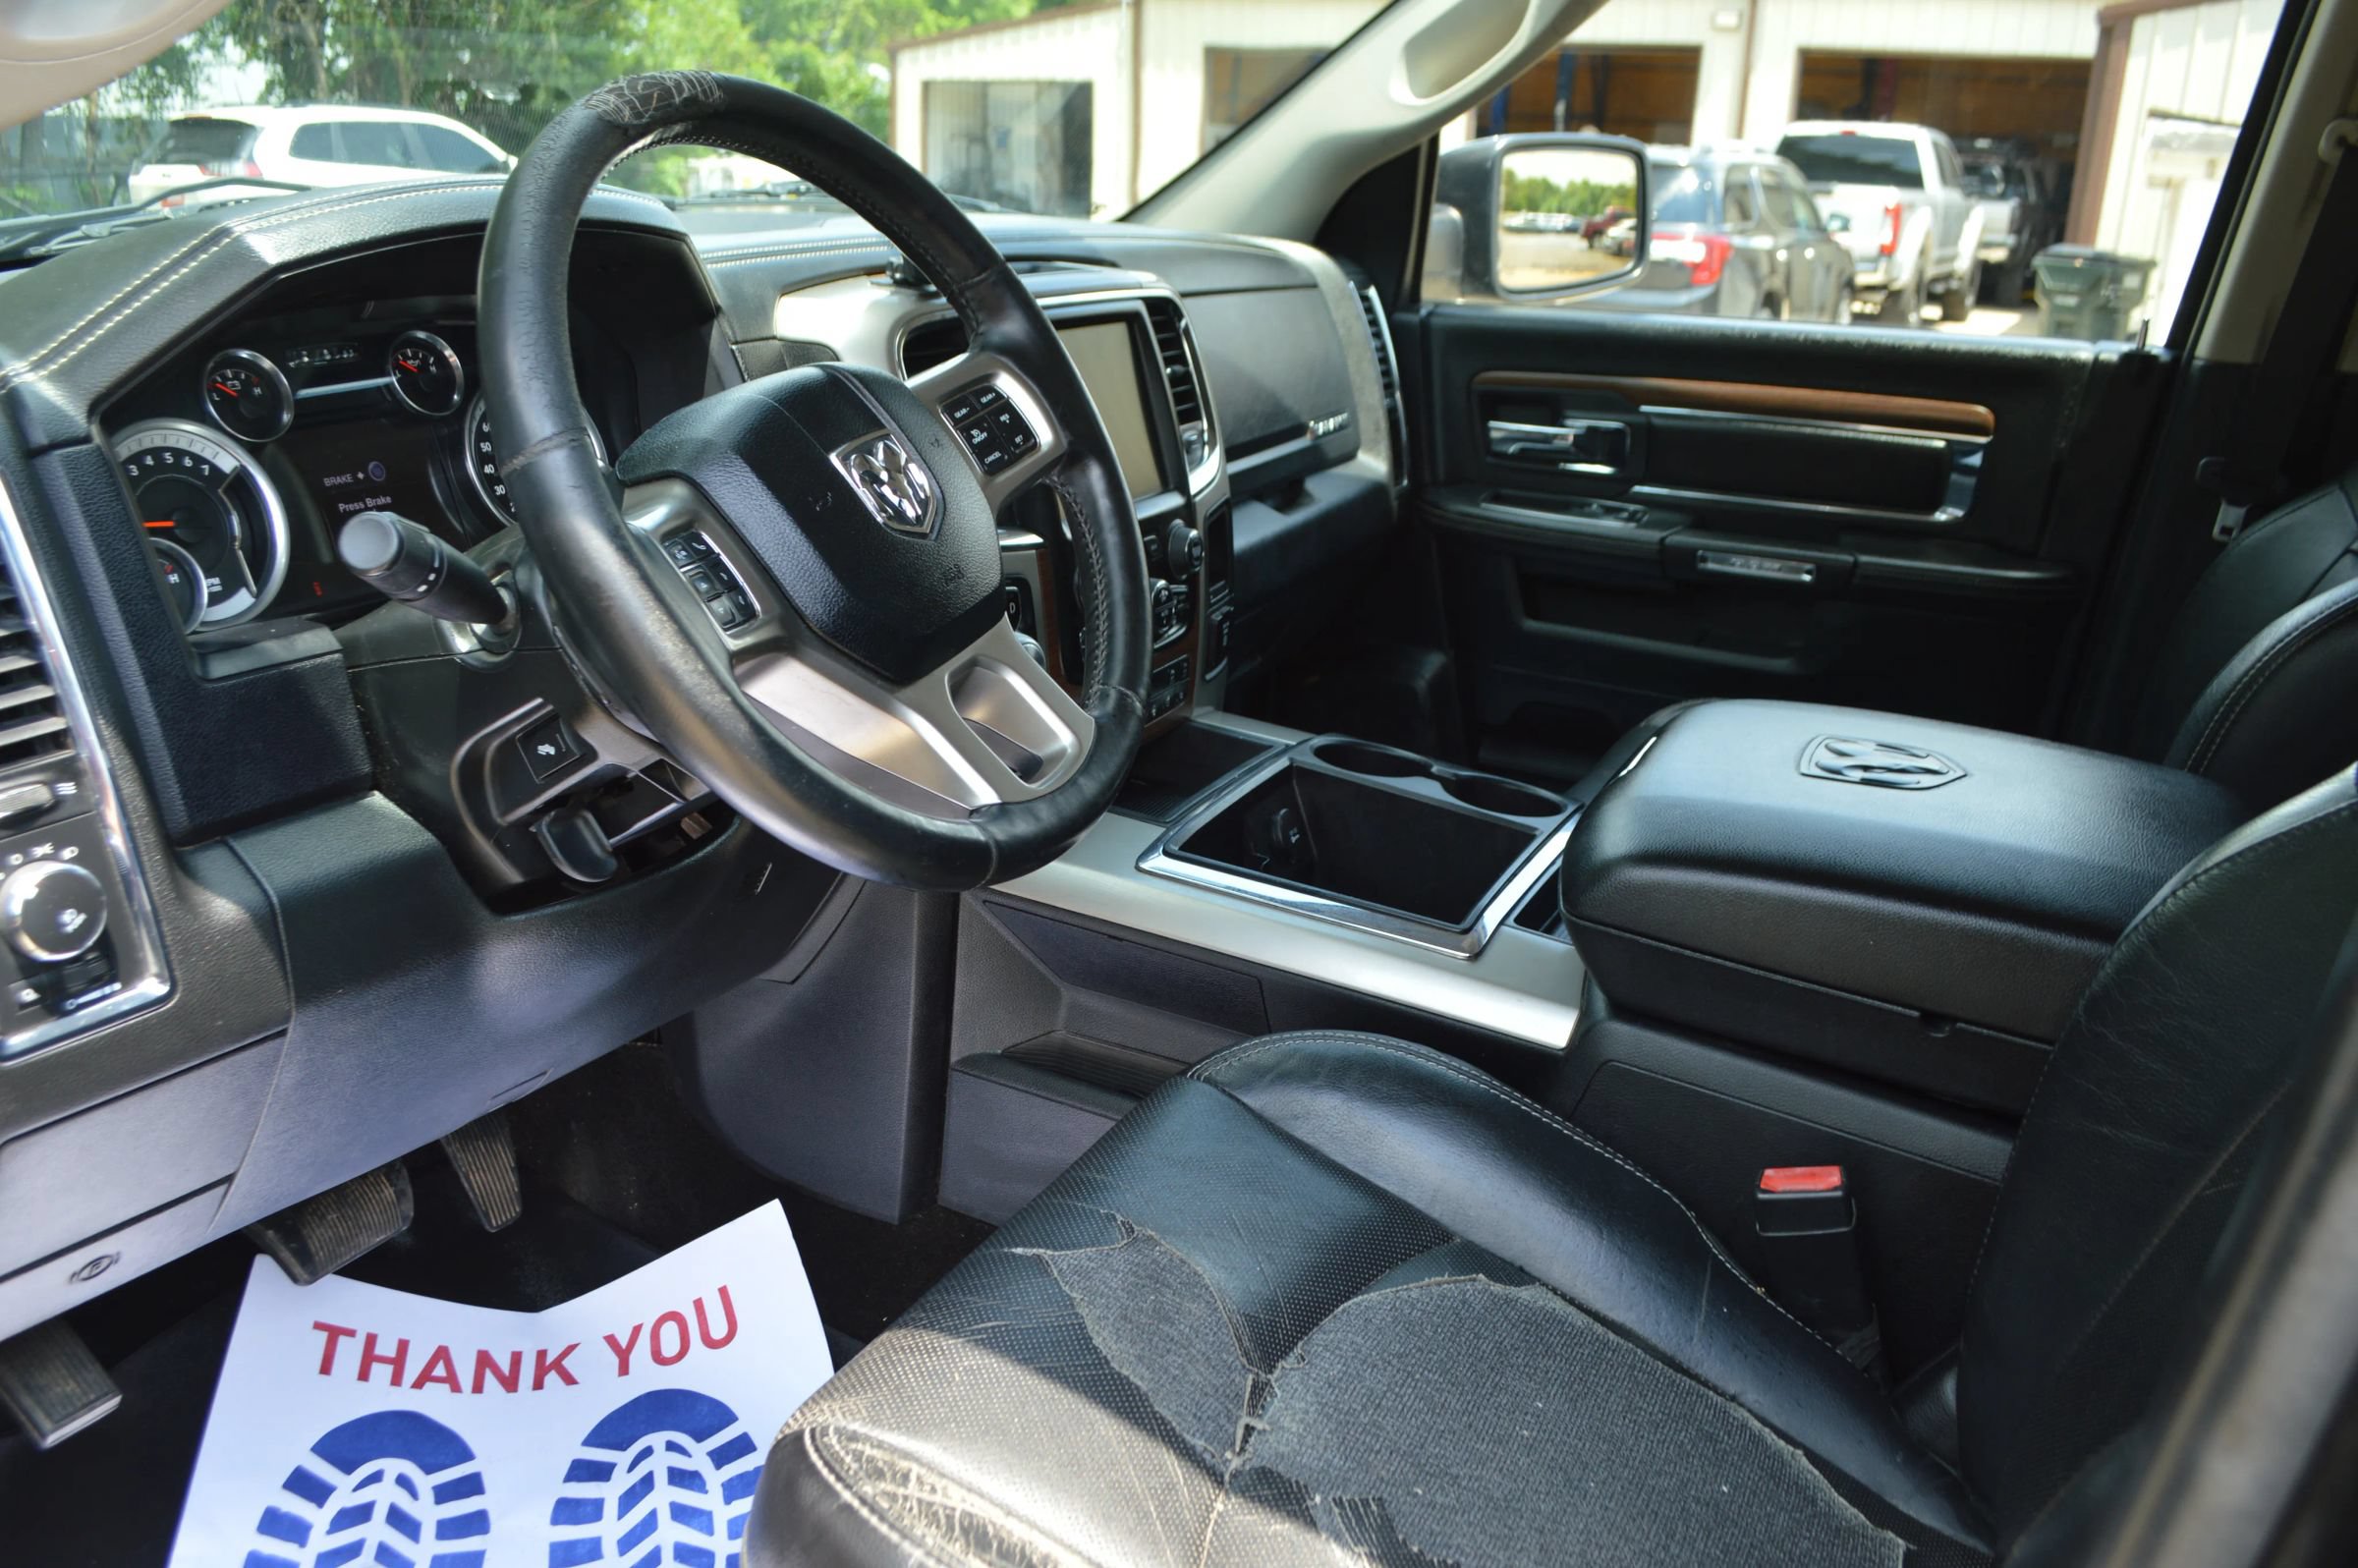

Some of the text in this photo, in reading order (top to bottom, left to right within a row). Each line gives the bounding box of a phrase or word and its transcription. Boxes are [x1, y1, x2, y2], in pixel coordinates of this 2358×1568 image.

[482, 421, 491, 432] 6
[479, 441, 491, 453] 50
[128, 452, 210, 476] 3 4 5 6 7
[984, 451, 1002, 465] CANCEL
[483, 464, 495, 474] 40
[323, 473, 355, 487] BRAKE
[494, 484, 506, 496] 30
[338, 494, 392, 513] Press Brake
[168, 573, 180, 585] H
[312, 1284, 738, 1394] THANK YOU
